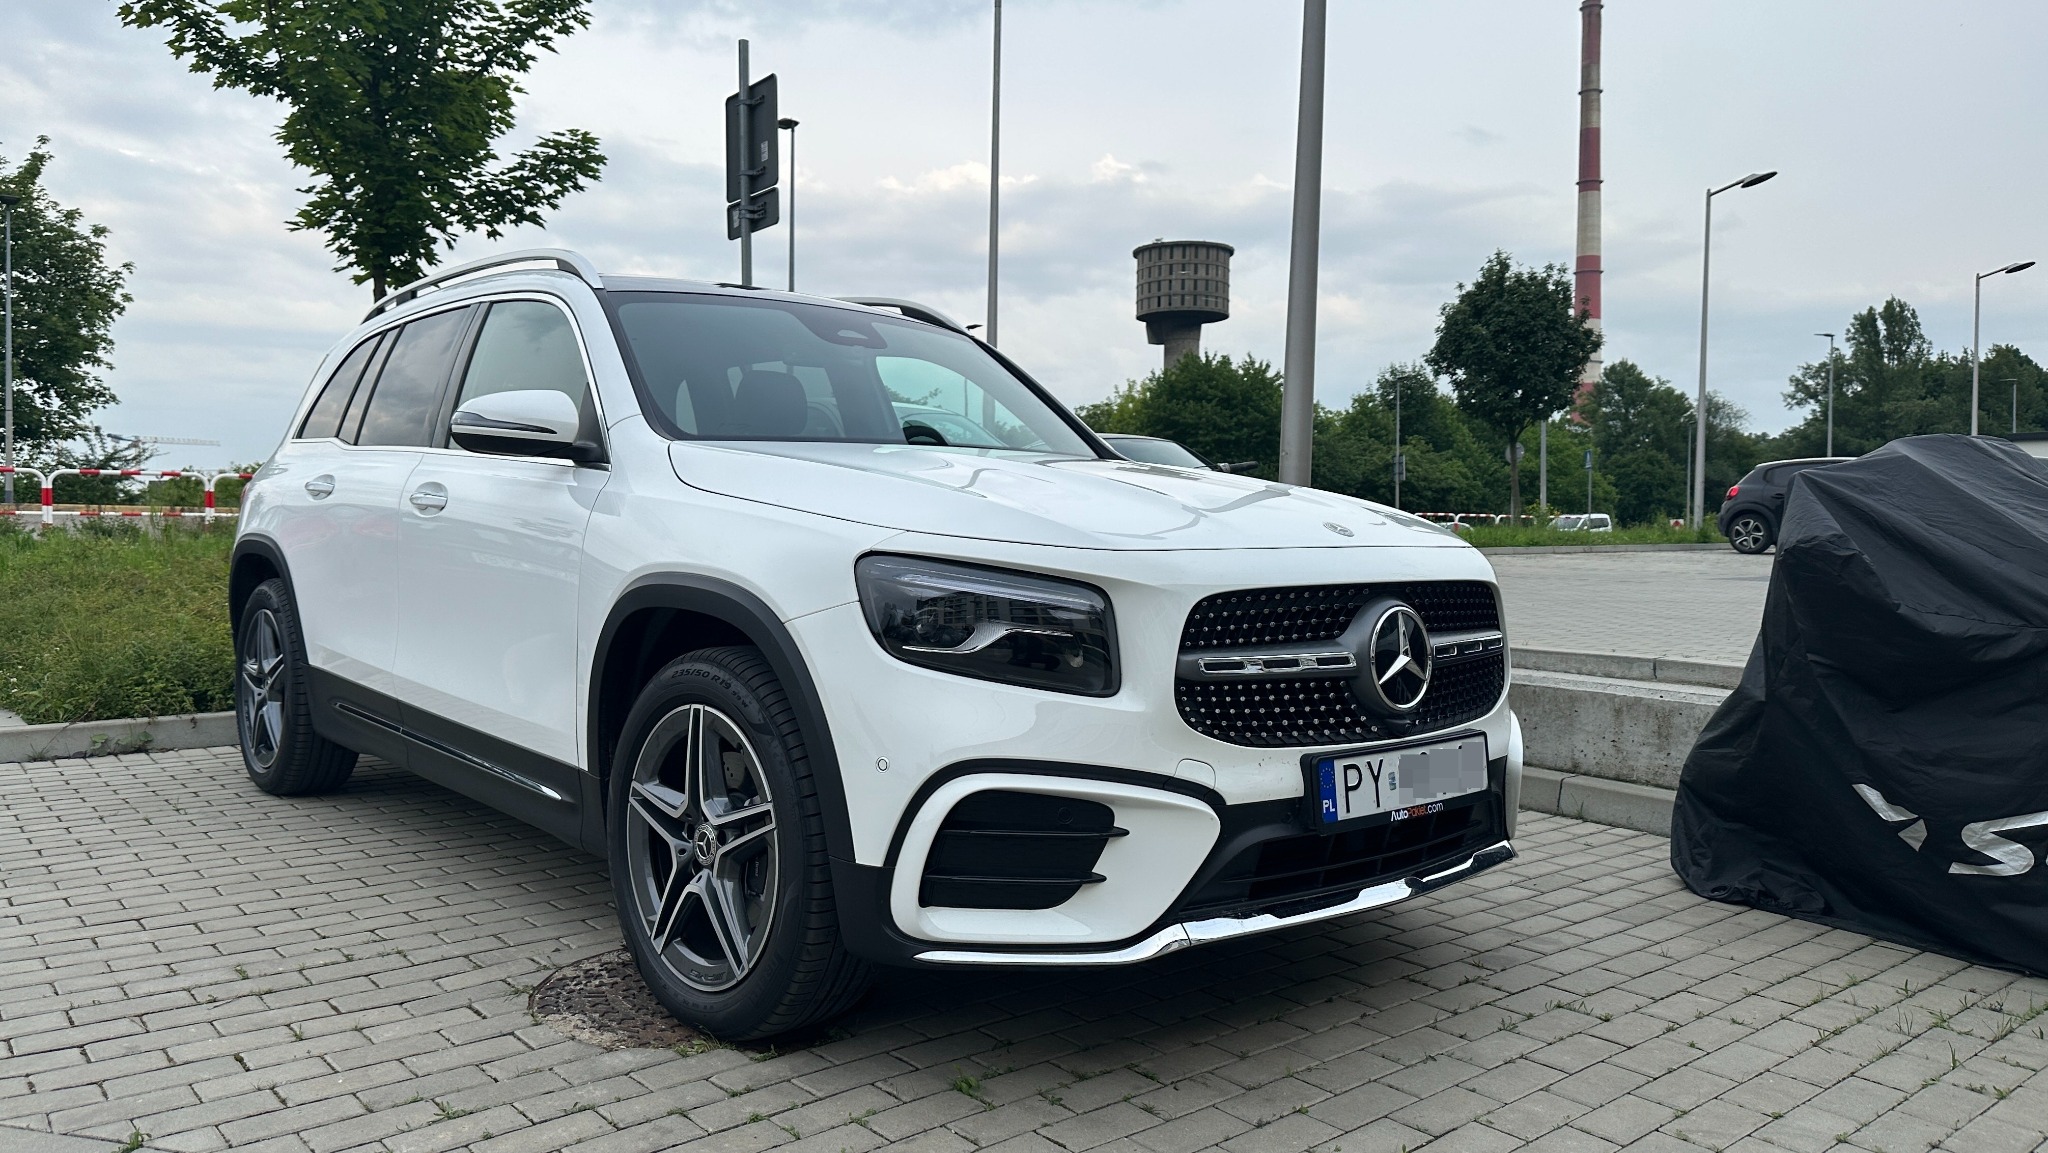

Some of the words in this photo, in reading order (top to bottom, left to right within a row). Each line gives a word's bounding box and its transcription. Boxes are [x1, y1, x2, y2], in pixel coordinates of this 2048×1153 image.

[672, 669, 710, 678] 235/50
[711, 675, 732, 689] R19
[1343, 758, 1384, 813] PY
[1323, 798, 1336, 814] PL
